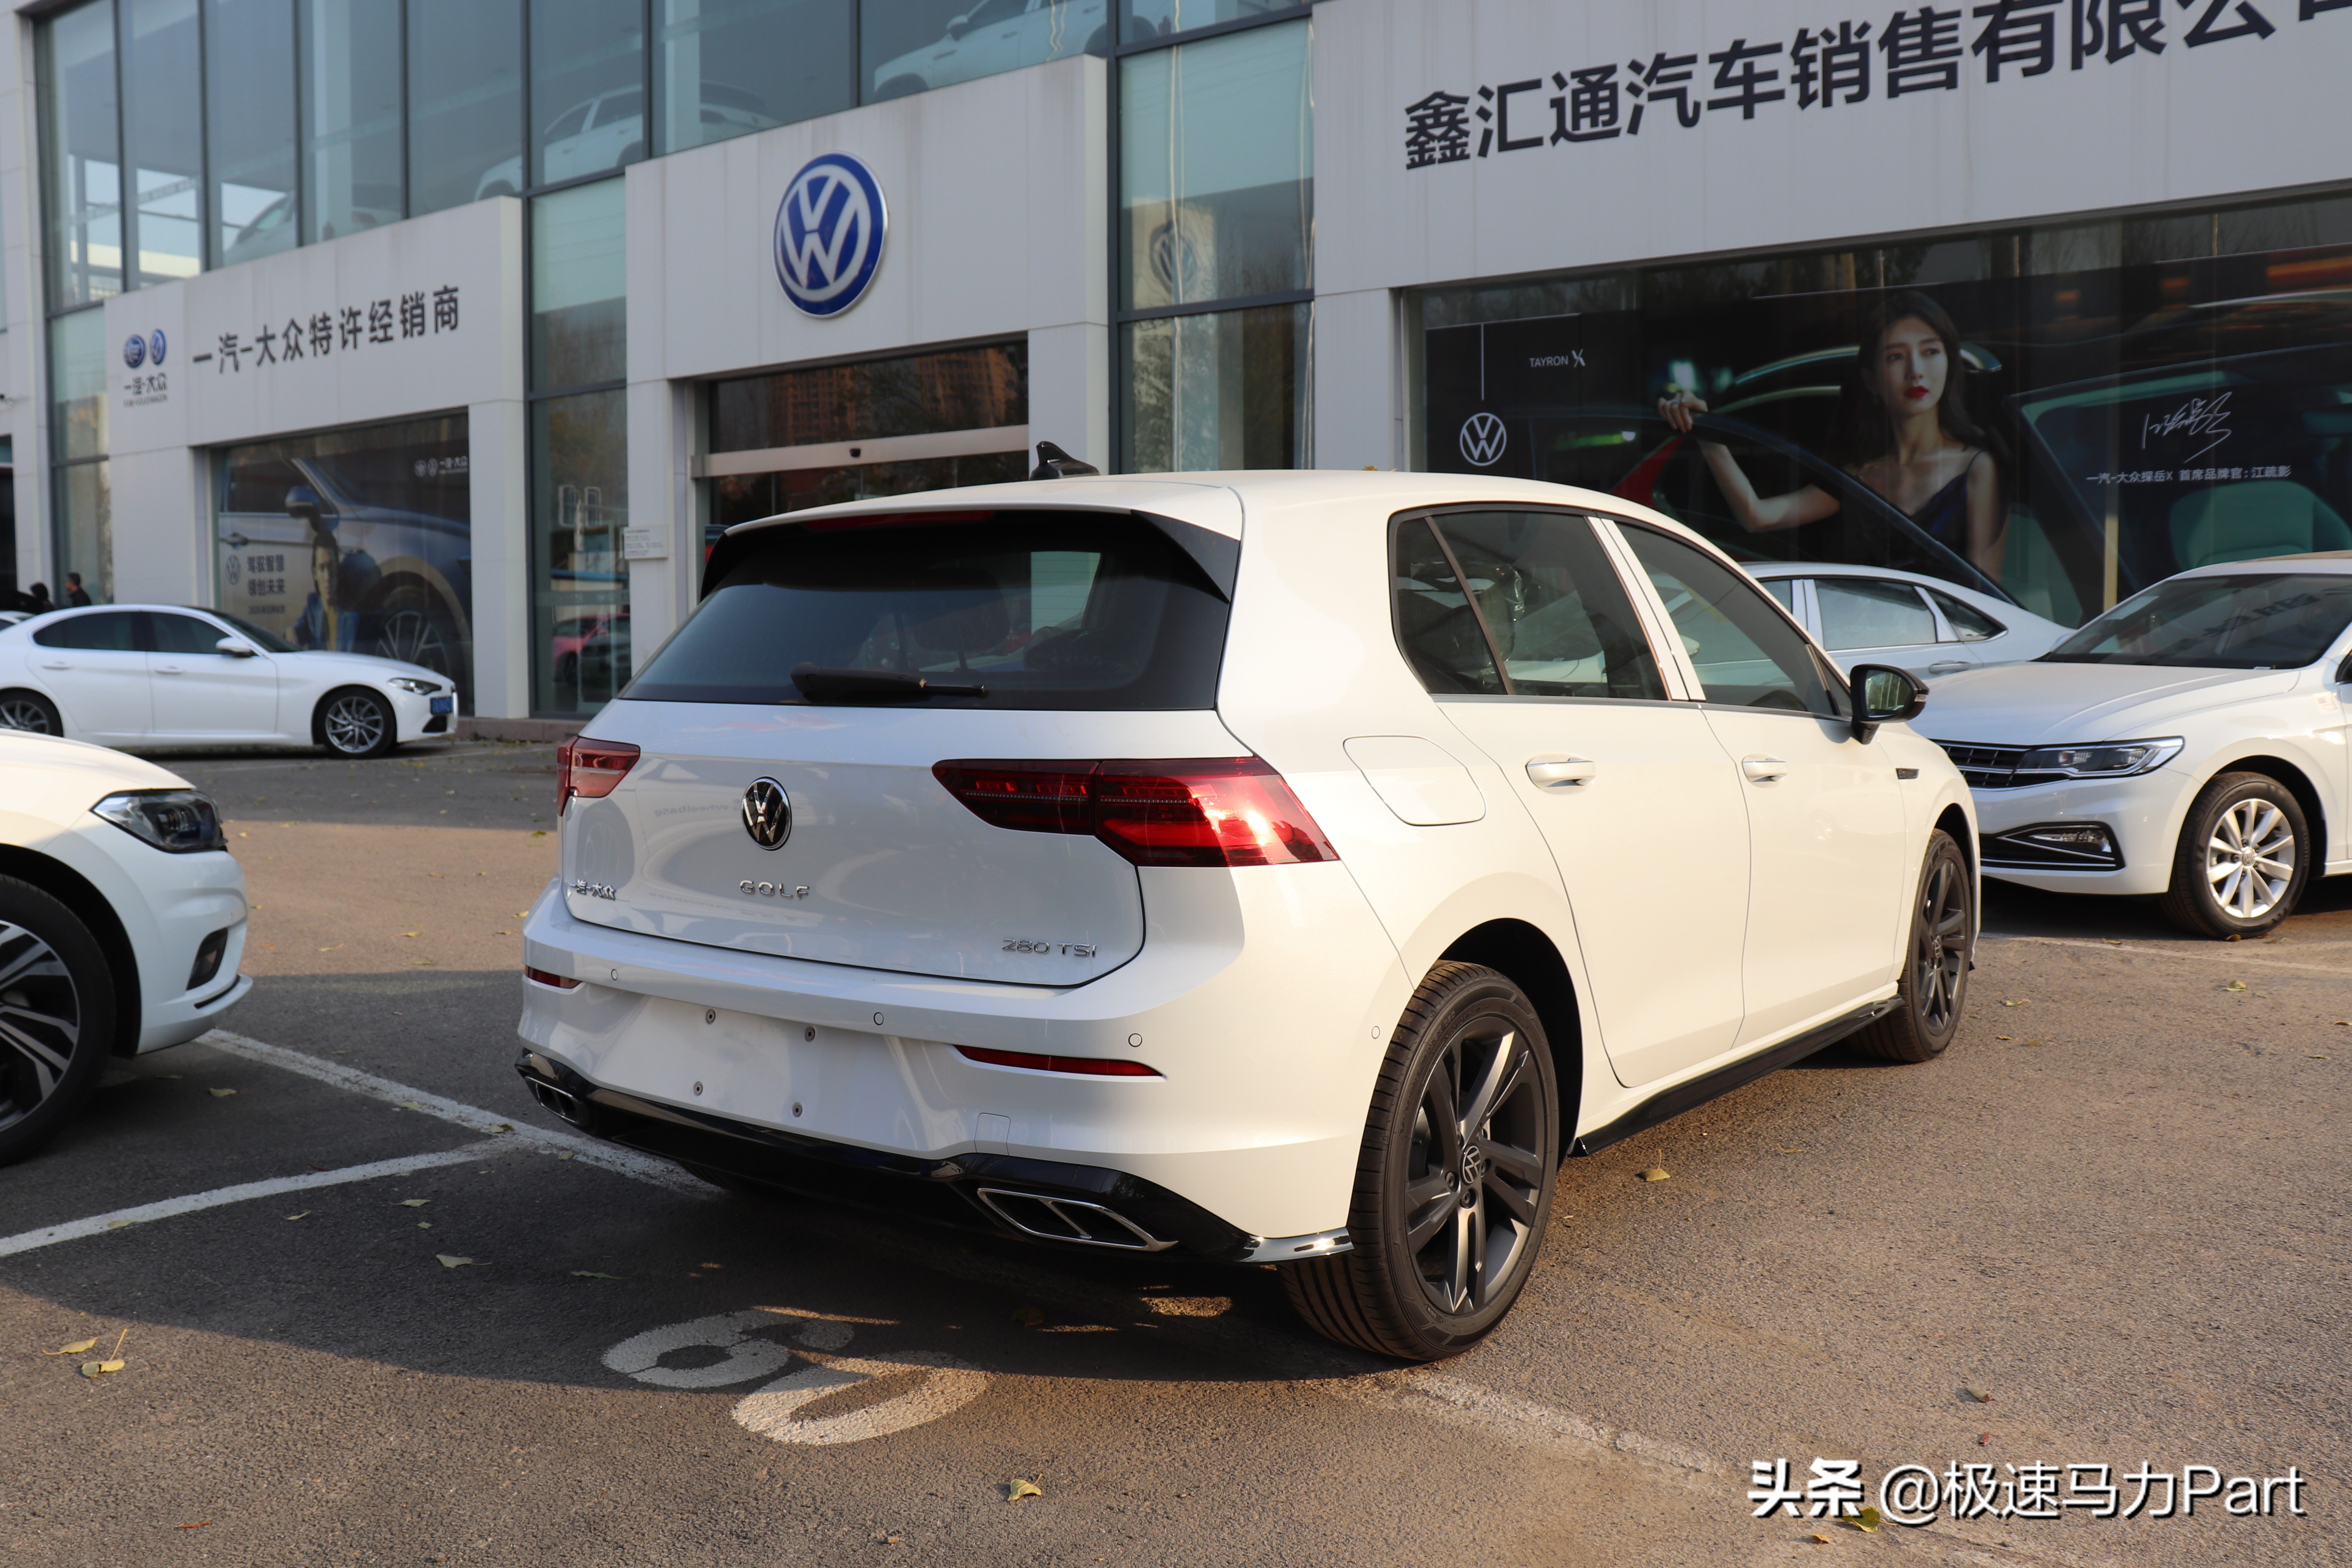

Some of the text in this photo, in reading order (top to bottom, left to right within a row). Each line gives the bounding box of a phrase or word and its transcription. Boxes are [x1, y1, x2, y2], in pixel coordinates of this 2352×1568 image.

[1405, 0, 2352, 170] 鑫汇通汽车销售有限公
[192, 285, 459, 374] 一汽-大众特许经销商
[1530, 348, 1586, 368] TAYRON X
[2086, 470, 2173, 484] 一汽-大众探岳X
[569, 878, 616, 901] 一汽-大众
[740, 879, 810, 900] GOLF
[1002, 938, 1097, 958] 280 TSI
